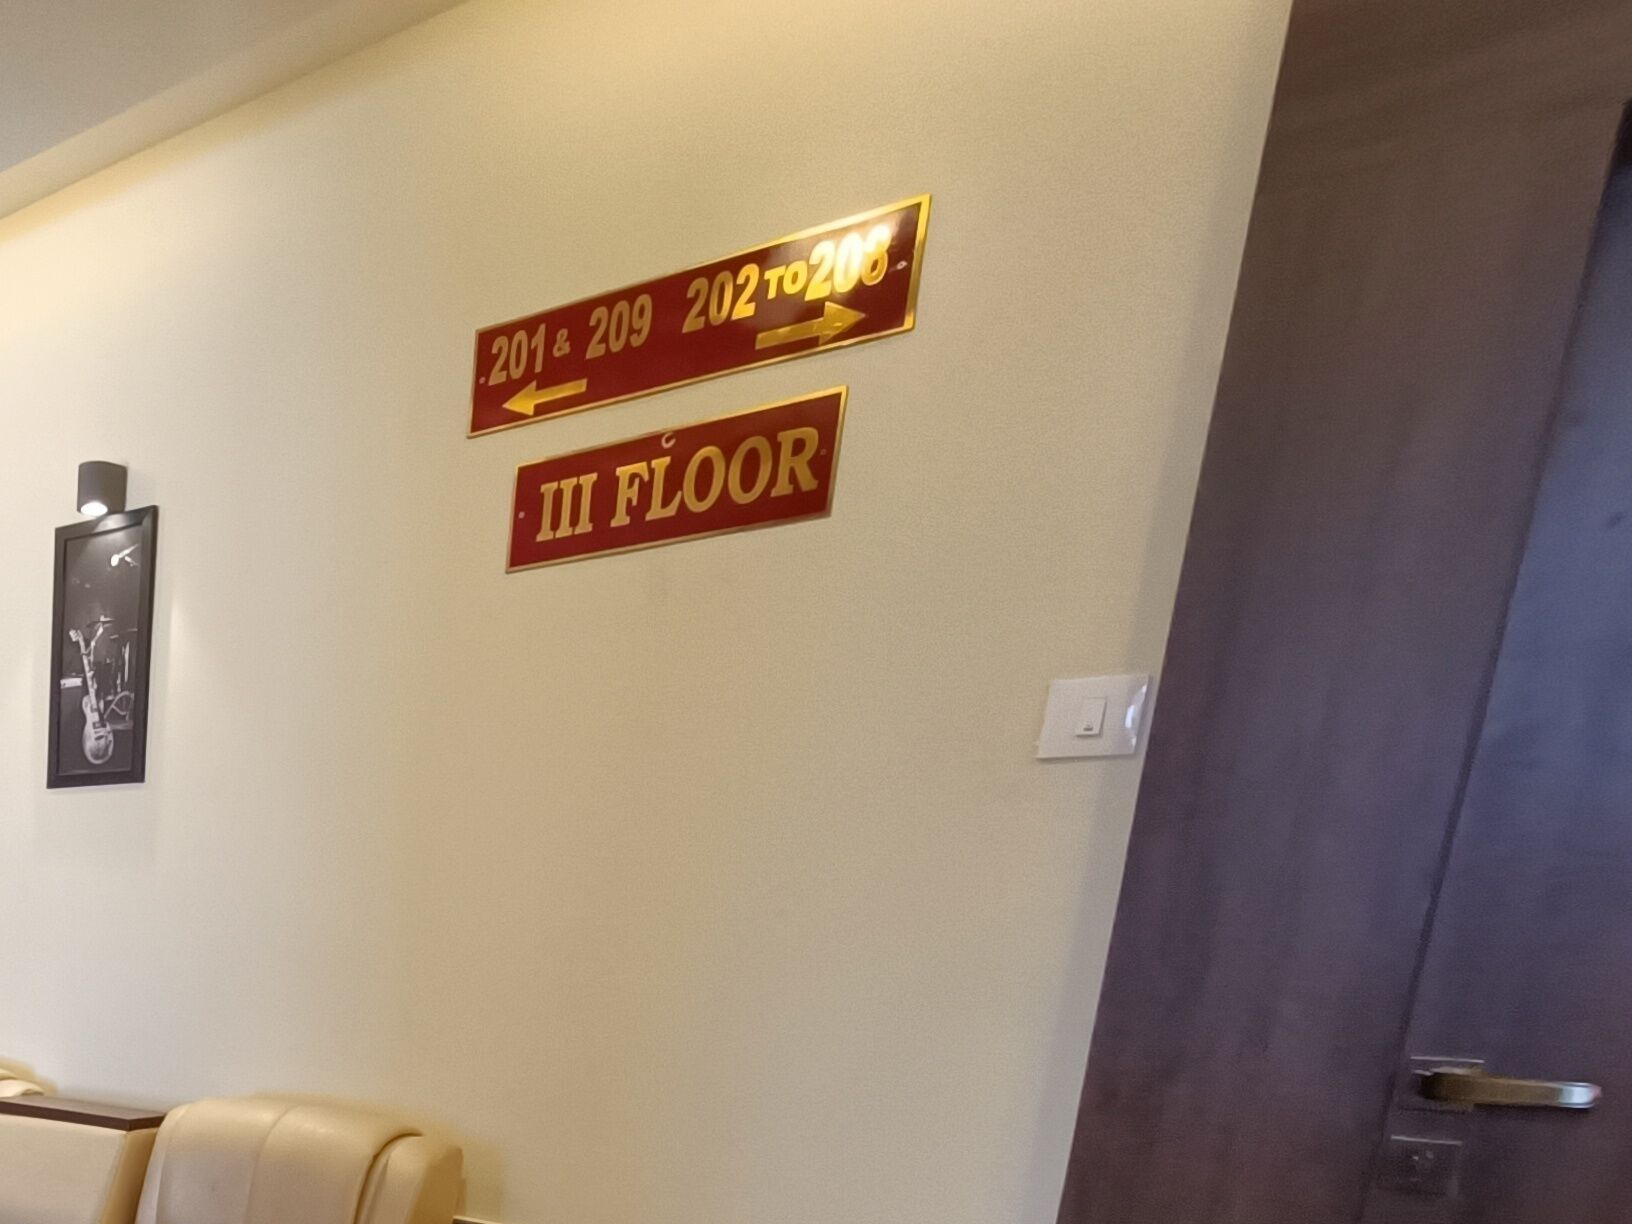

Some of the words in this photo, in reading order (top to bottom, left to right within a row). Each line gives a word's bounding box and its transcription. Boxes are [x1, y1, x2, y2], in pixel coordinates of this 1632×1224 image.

[488, 324, 547, 386] 201
[552, 328, 571, 358] &
[585, 293, 653, 360] 209
[681, 263, 760, 334] 202
[535, 472, 598, 542] III
[609, 426, 821, 528] FLOOR
